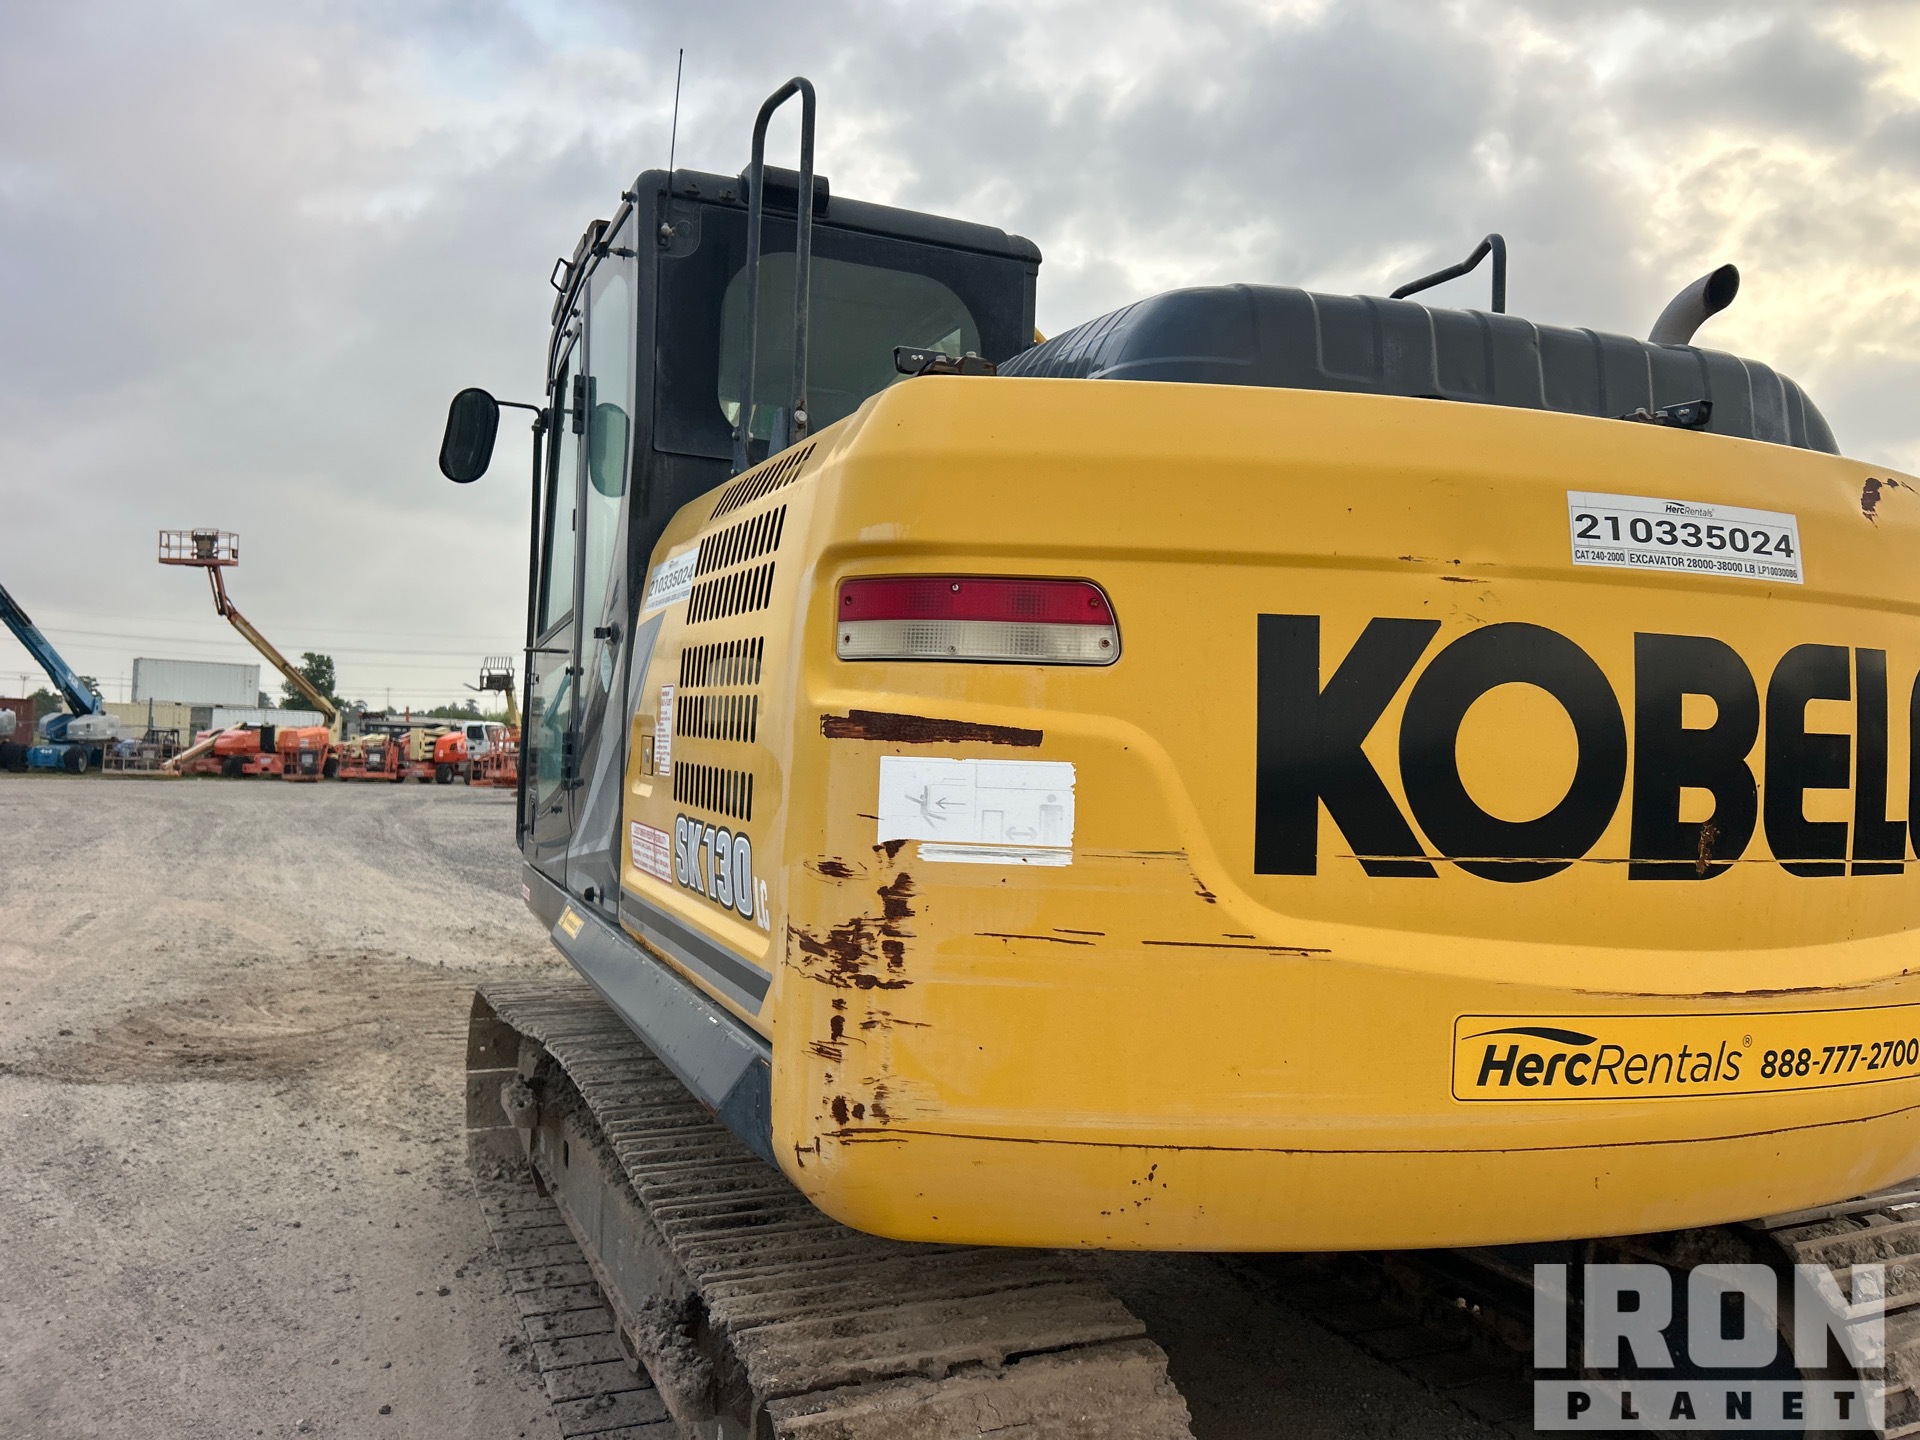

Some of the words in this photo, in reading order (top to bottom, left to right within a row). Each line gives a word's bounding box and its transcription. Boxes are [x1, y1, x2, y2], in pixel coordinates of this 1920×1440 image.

[1575, 513, 1794, 558] 210335024
[1575, 549, 1590, 560] CAT
[1591, 550, 1625, 563] 240-2000
[648, 563, 695, 597] 210335024
[1629, 553, 1684, 567] EXCAVATOR
[1687, 558, 1743, 572] 28000-38000
[1744, 563, 1756, 574] LB
[1254, 613, 1920, 884] KOBEL
[675, 813, 754, 921] SK130
[754, 876, 771, 932] LC
[1760, 1037, 1920, 1080] 888-777-2700
